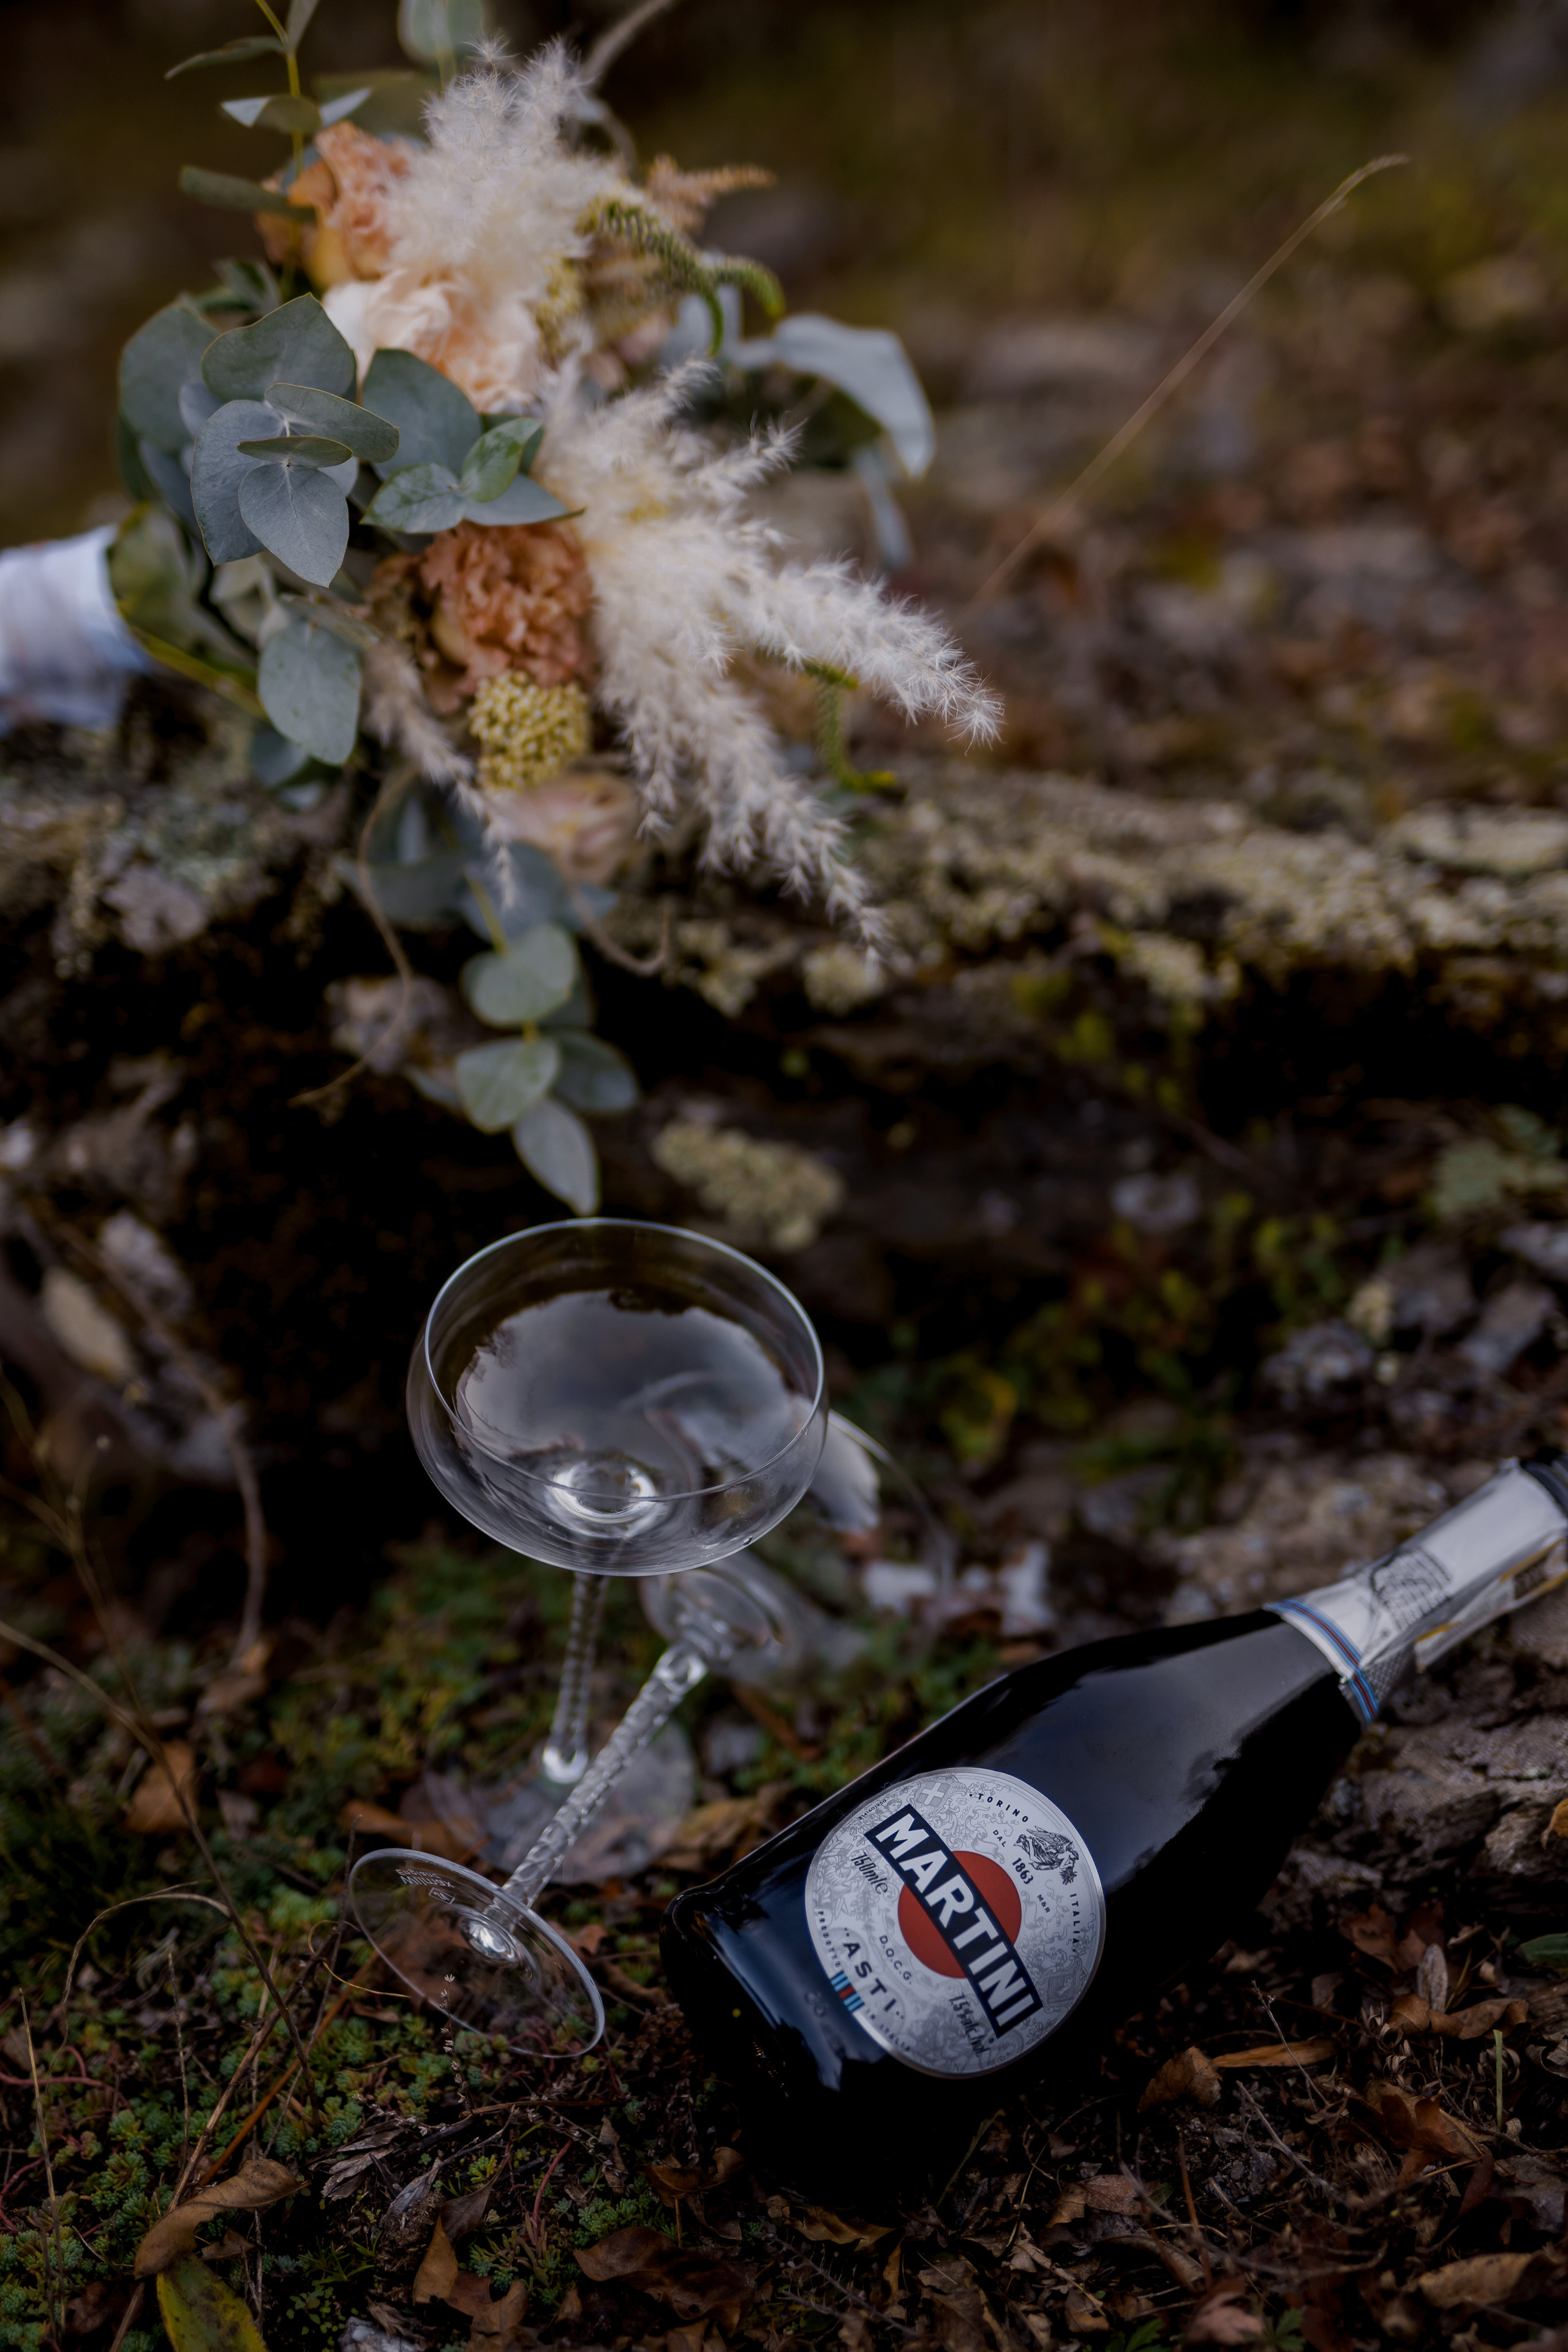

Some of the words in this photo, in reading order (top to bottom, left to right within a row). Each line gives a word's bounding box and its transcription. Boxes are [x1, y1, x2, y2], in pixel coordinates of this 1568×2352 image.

[978, 1793, 1028, 1823] TORINO
[992, 1830, 1006, 1847] DAL
[1012, 1857, 1034, 1885] 1863
[875, 1813, 1035, 2027] MARTINI
[1036, 1894, 1050, 1914] M&R
[1069, 1893, 1080, 1945] ITALIA
[843, 1942, 897, 2013] ASTI
[879, 1934, 913, 1985] D.O.C.G.
